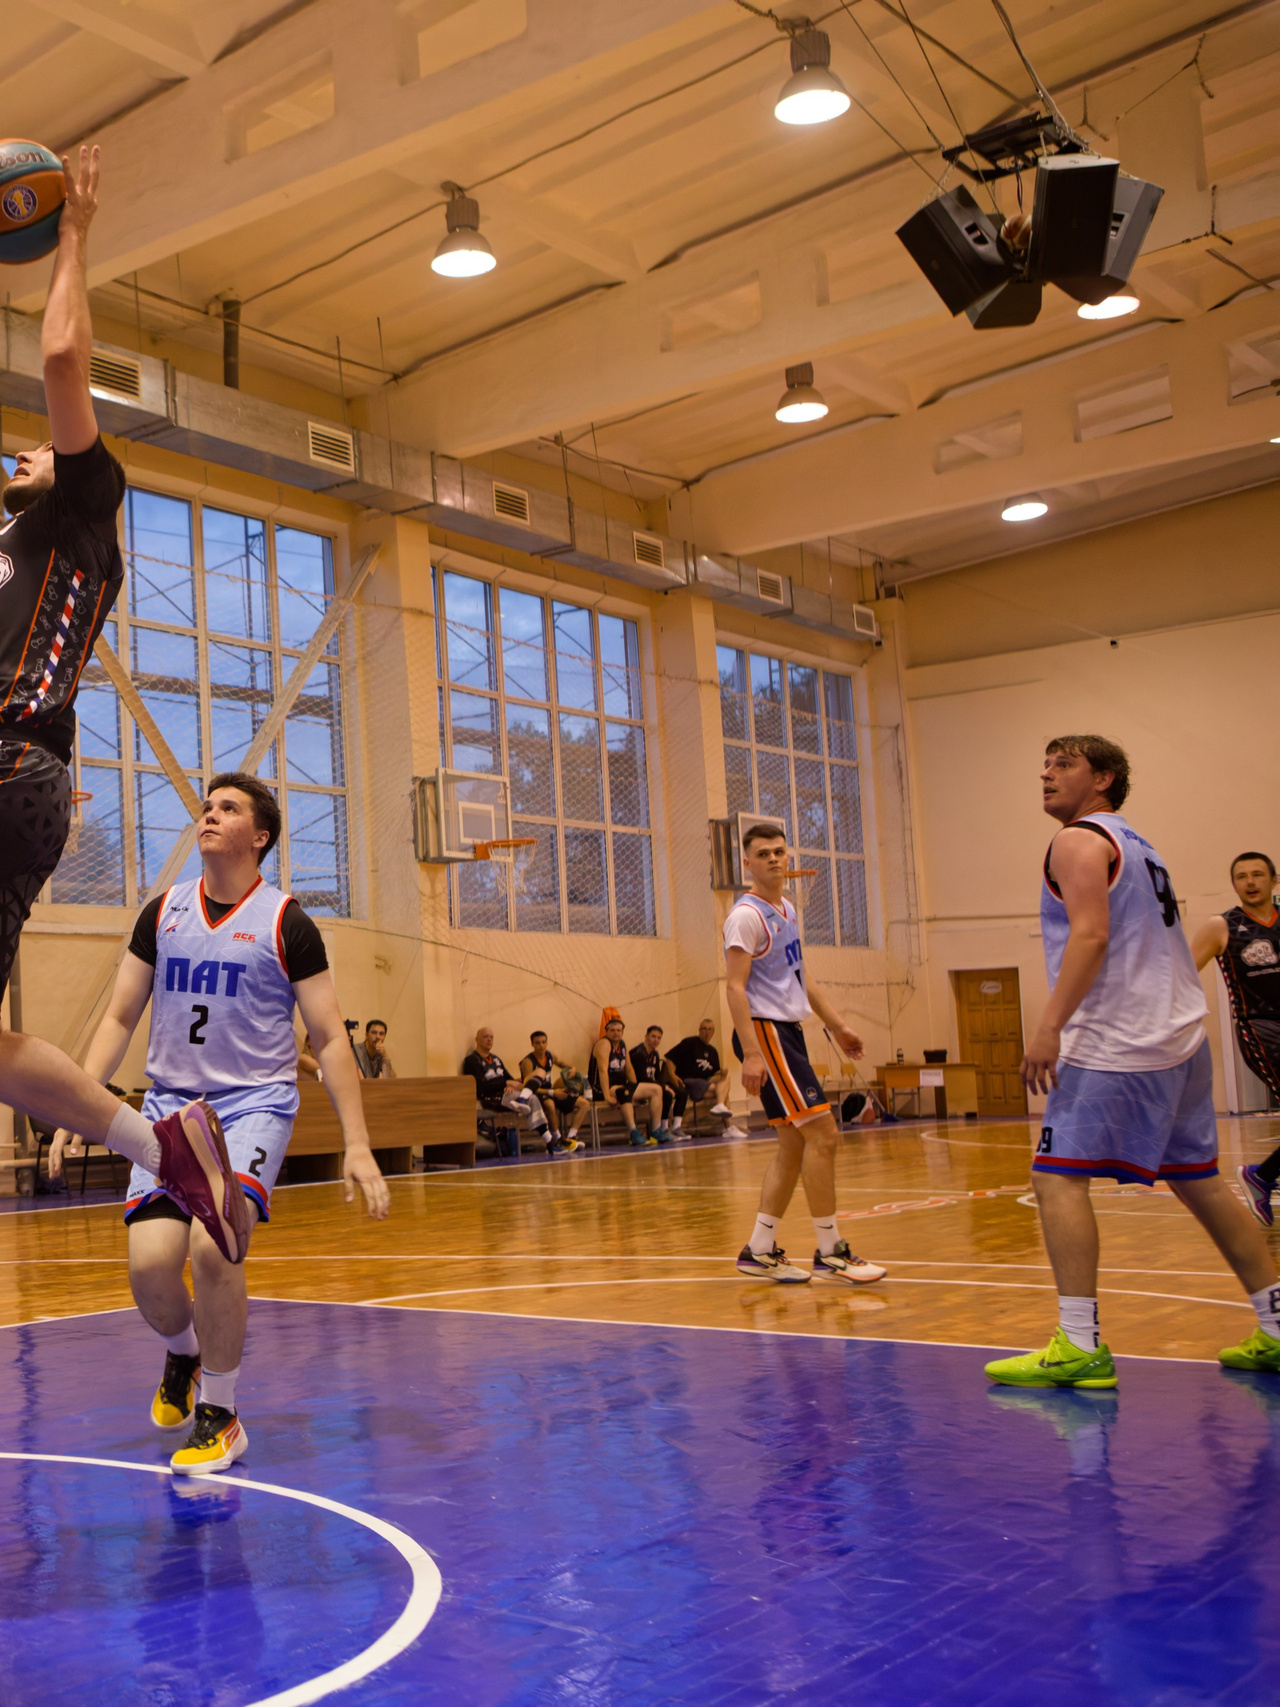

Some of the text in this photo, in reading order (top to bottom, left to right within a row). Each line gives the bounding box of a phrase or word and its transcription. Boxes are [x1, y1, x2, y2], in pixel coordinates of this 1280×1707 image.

[166, 957, 247, 997] ПАТ
[189, 1004, 209, 1045] 2
[248, 1146, 267, 1178] 2
